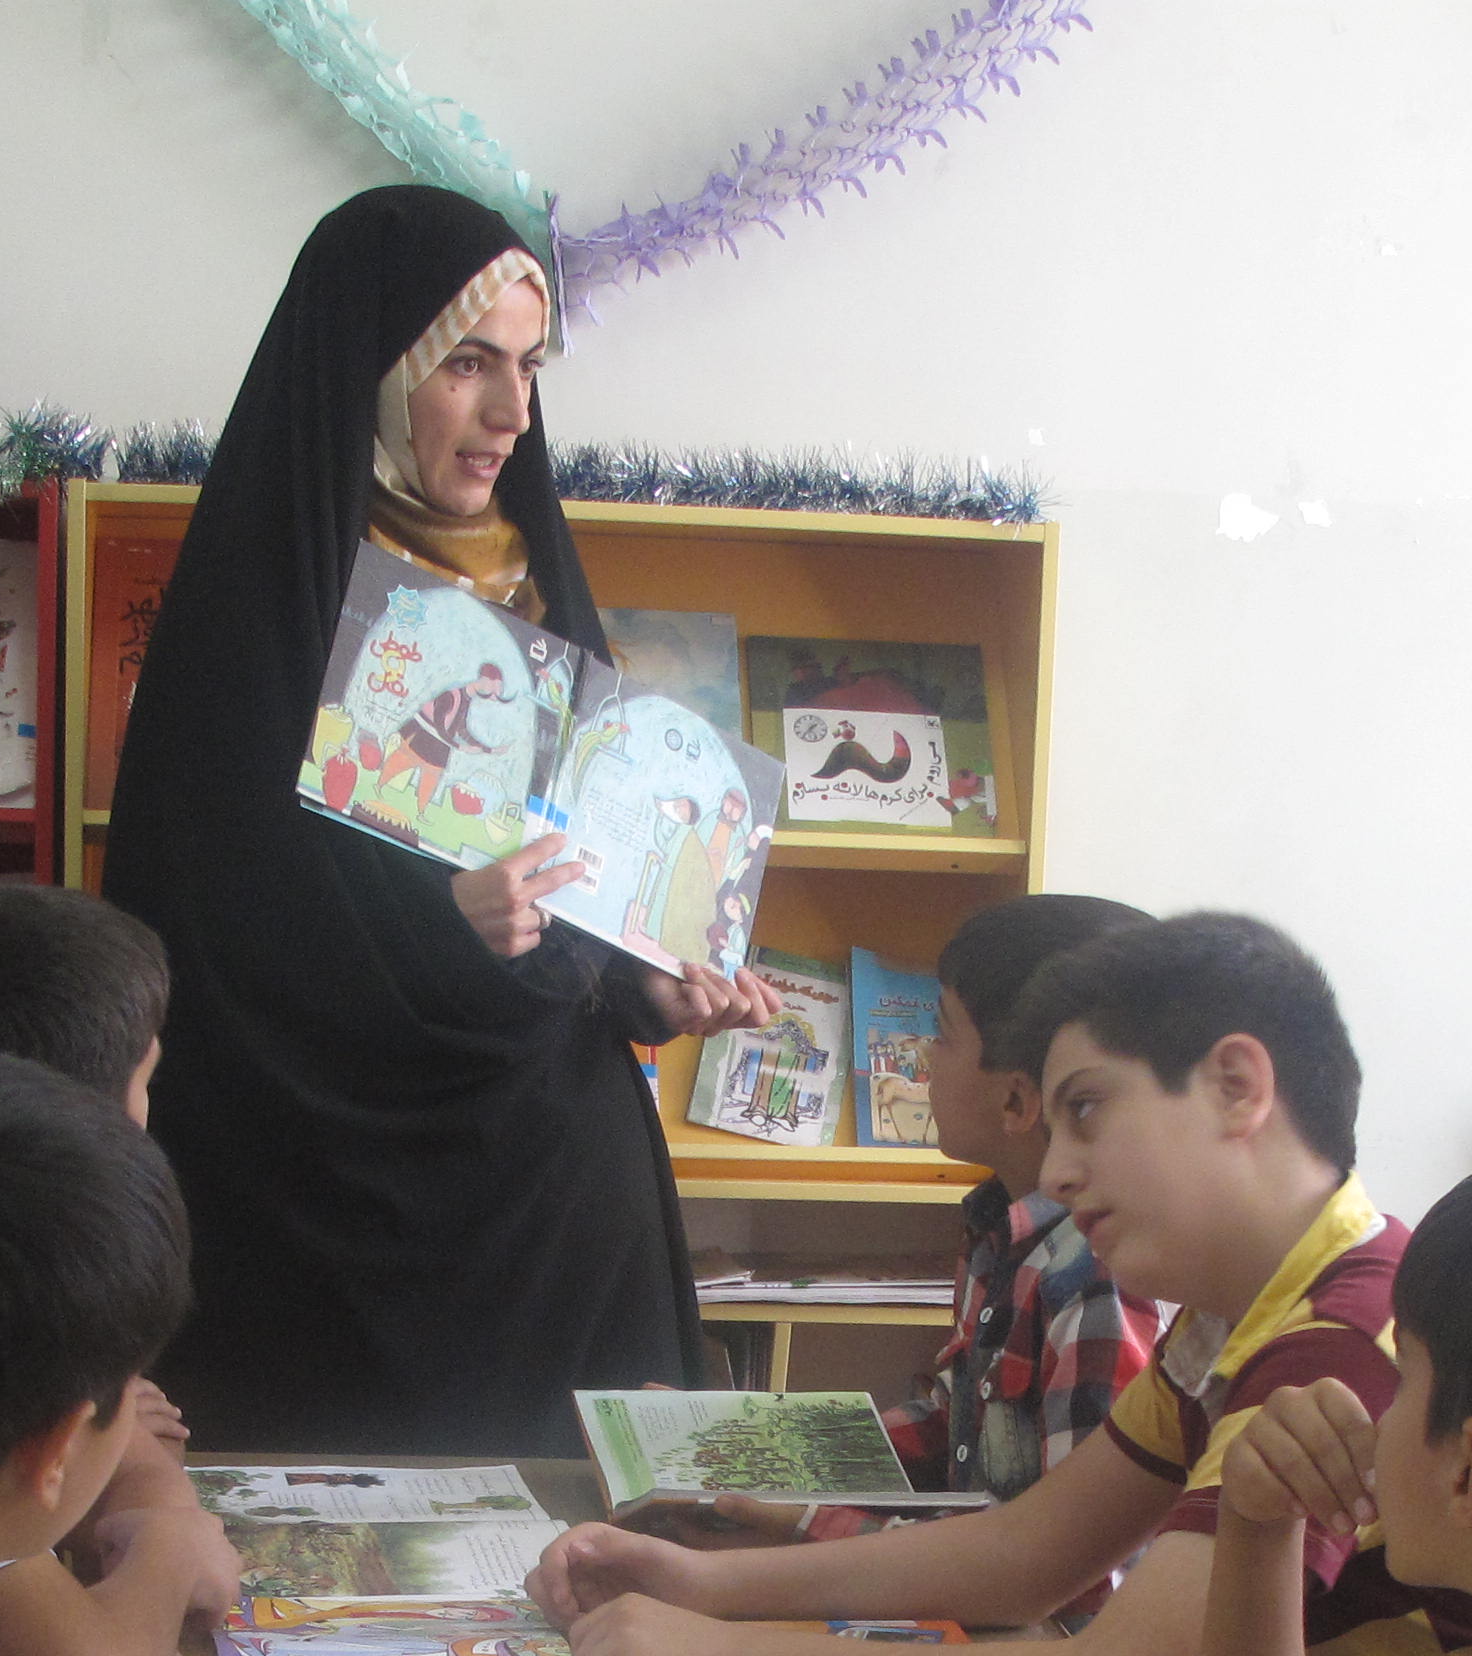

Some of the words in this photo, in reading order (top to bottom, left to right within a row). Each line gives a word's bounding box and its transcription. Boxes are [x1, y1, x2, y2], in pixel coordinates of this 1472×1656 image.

[792, 781, 830, 806] بسازم
[832, 782, 864, 797] لانه
[903, 783, 934, 804] برای
